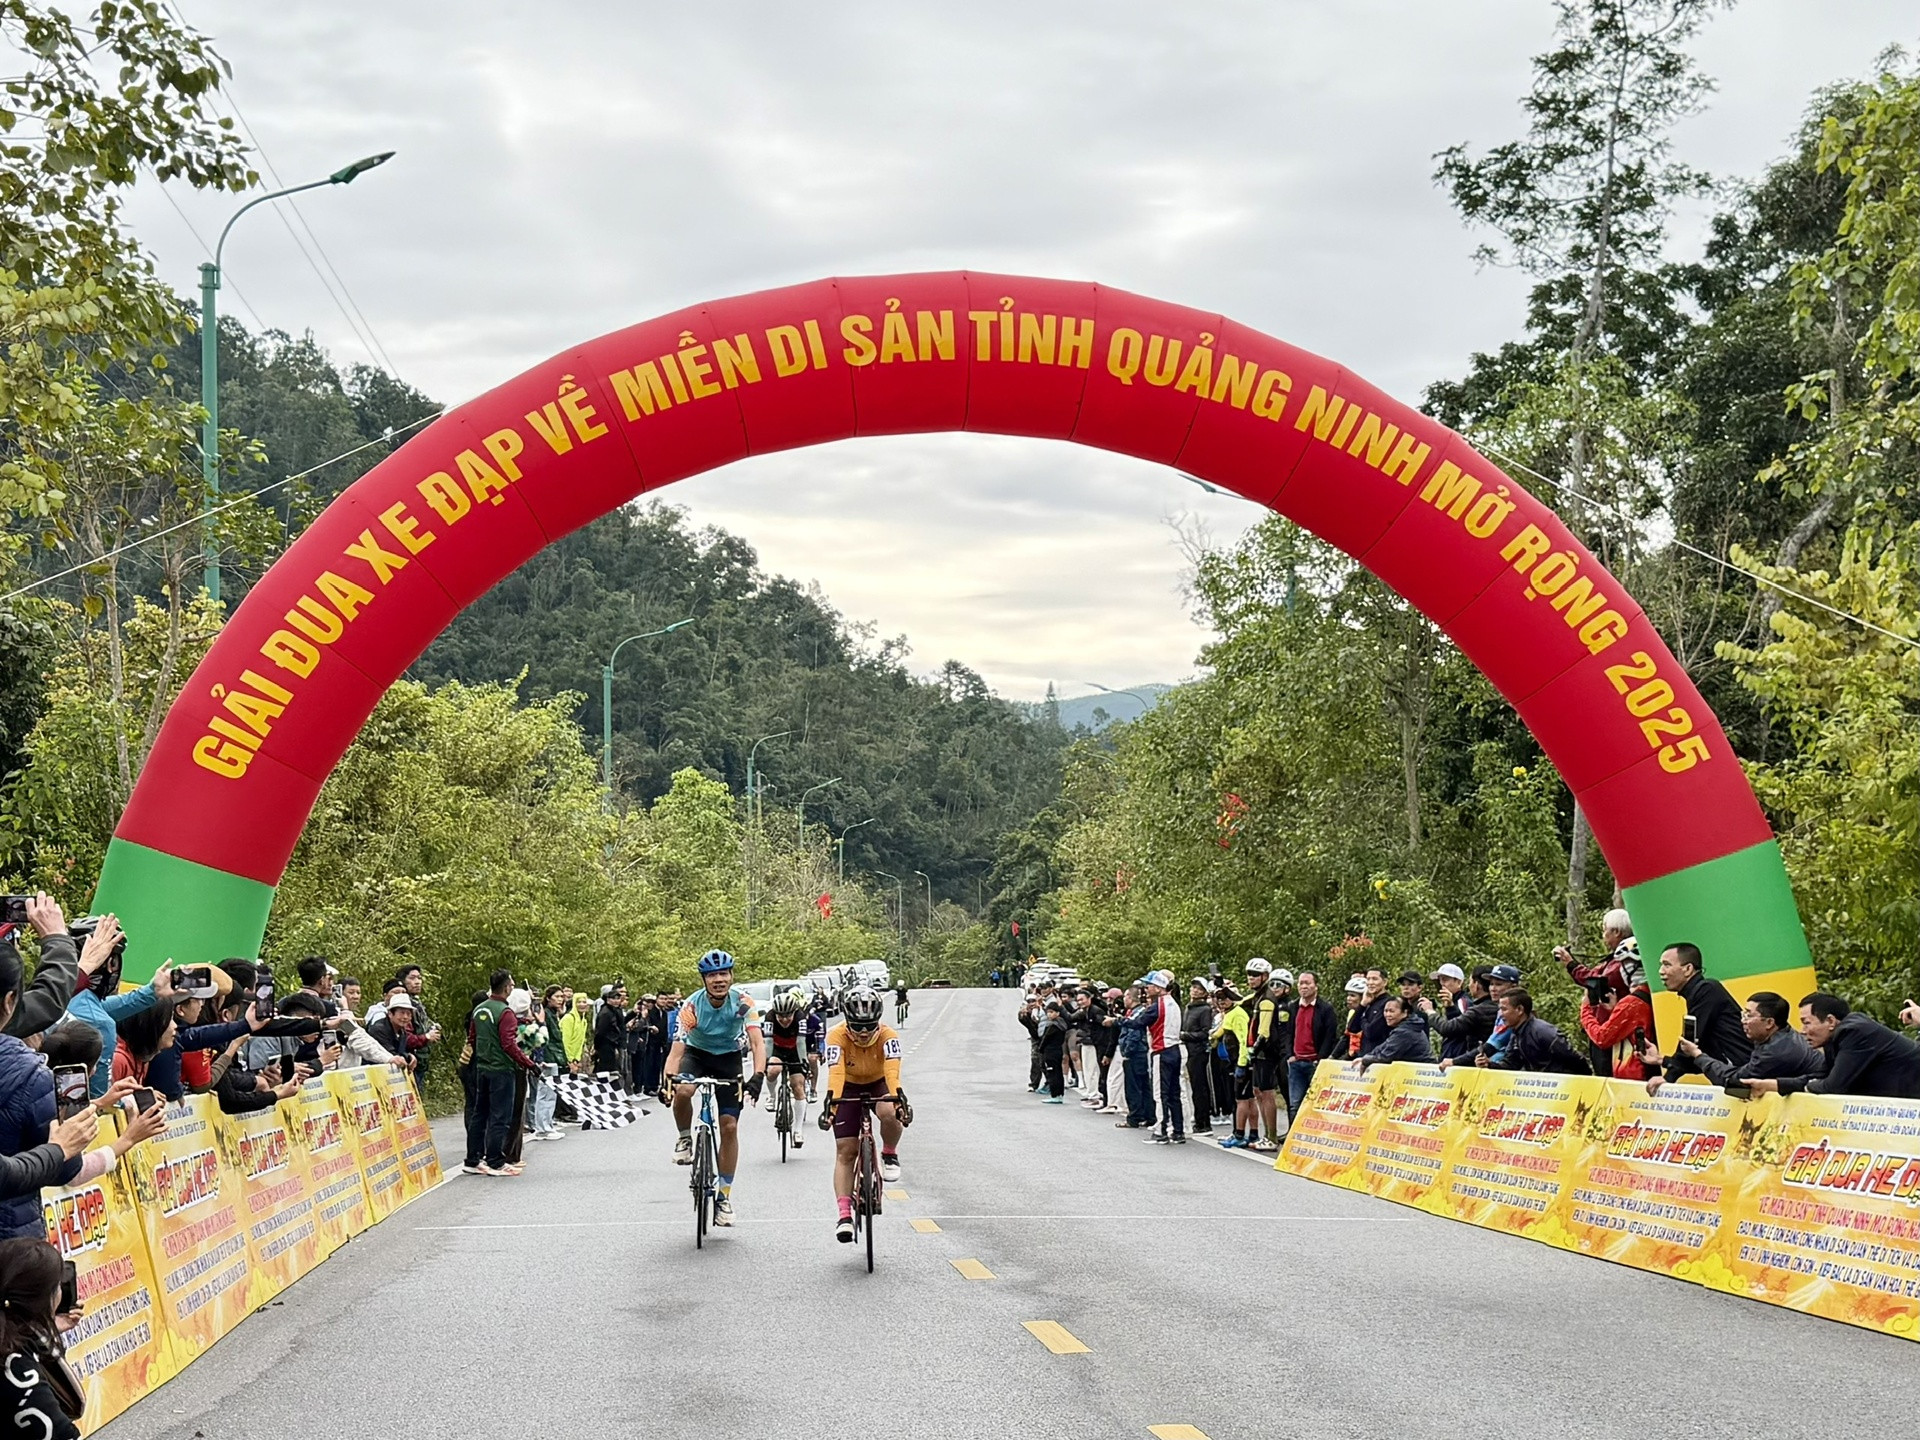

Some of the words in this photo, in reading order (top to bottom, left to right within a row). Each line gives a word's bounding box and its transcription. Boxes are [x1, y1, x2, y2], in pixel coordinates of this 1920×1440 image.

[193, 670, 294, 778] GIẢI
[260, 570, 375, 679] ĐUA
[344, 501, 436, 585] XE
[416, 428, 524, 525] ĐẠP
[524, 374, 608, 455] VỀ
[608, 330, 762, 422] MIỀN
[751, 319, 827, 377] DI
[840, 297, 955, 367] SẢN
[968, 296, 1094, 368] TỈNH
[1106, 327, 1293, 422] QUẢNG
[1294, 384, 1432, 486] NINH
[1419, 459, 1517, 539] MỞ
[1499, 523, 1629, 655] RỘNG
[1604, 651, 1711, 773] 2025
